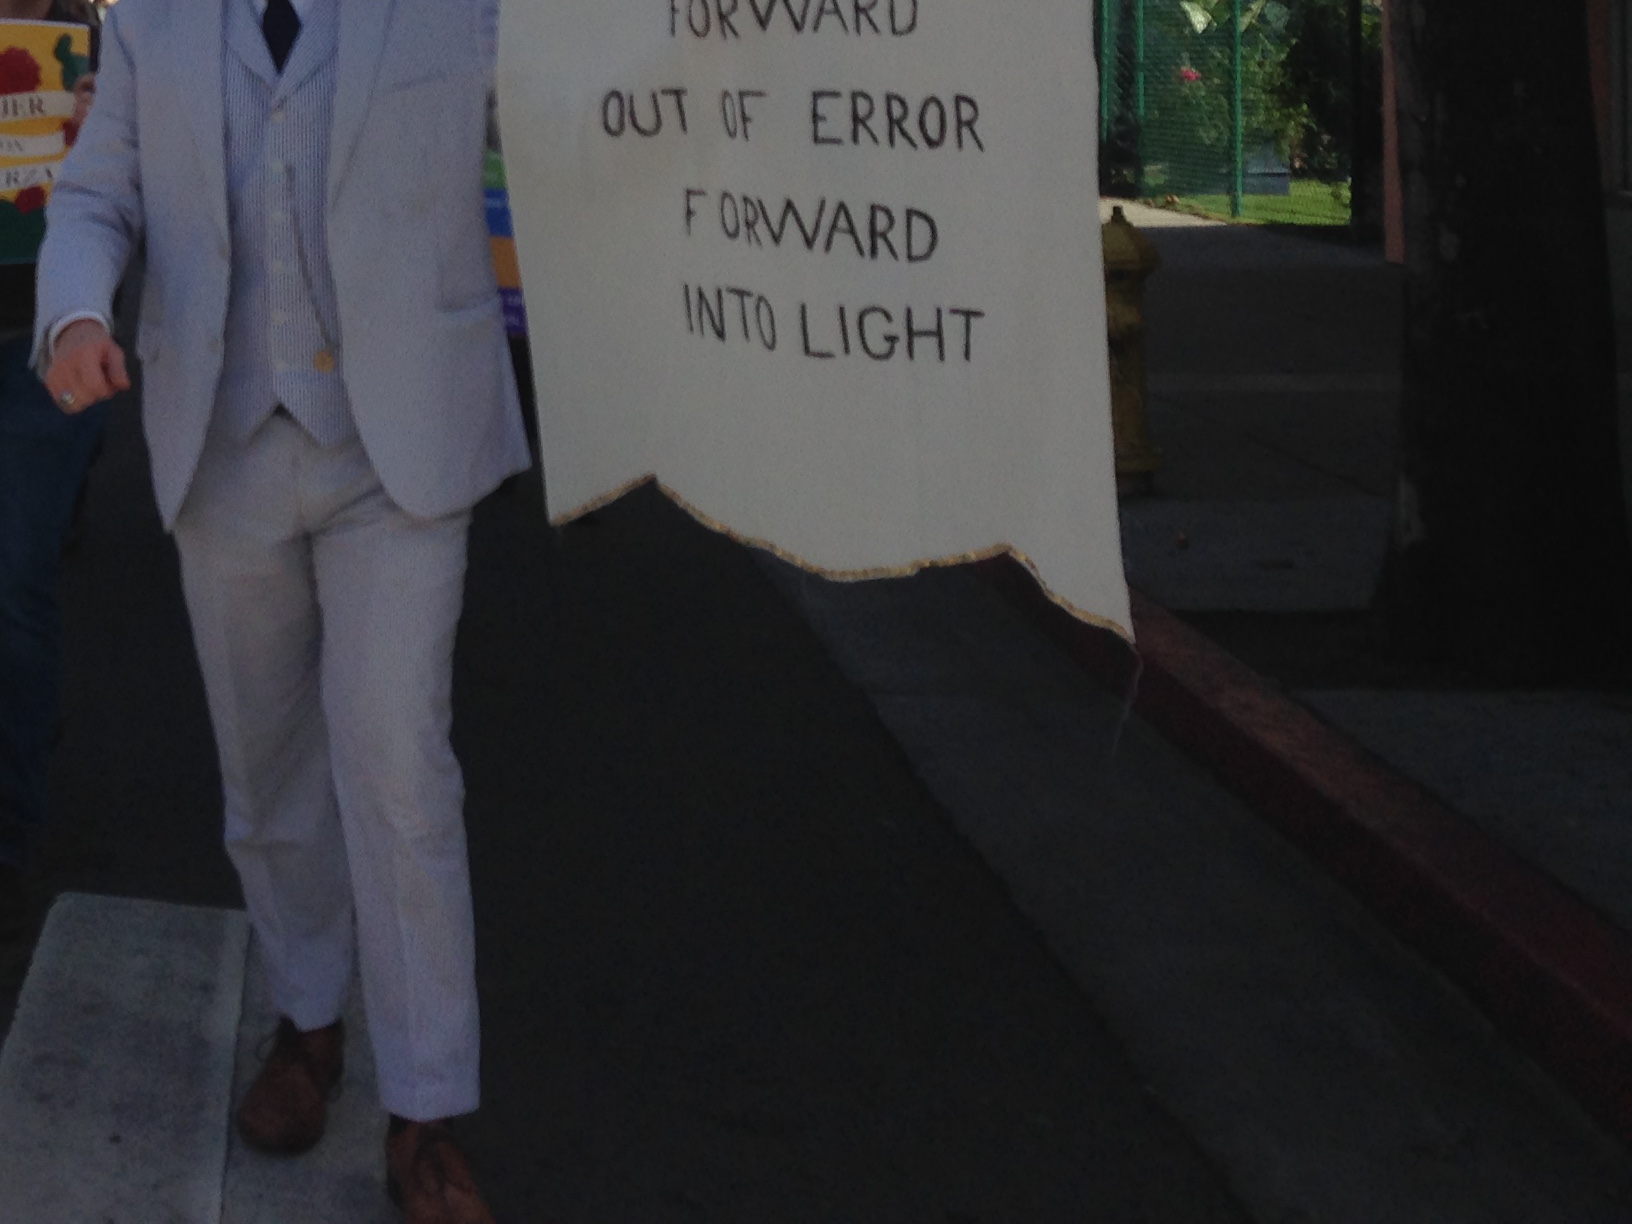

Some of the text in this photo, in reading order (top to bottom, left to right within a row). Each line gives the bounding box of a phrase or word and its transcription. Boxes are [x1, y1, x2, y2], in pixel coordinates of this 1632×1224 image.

[601, 87, 984, 152] OUT OF ERROR
[685, 188, 939, 263] FORWARD
[683, 283, 985, 362] INTO LIGHT
